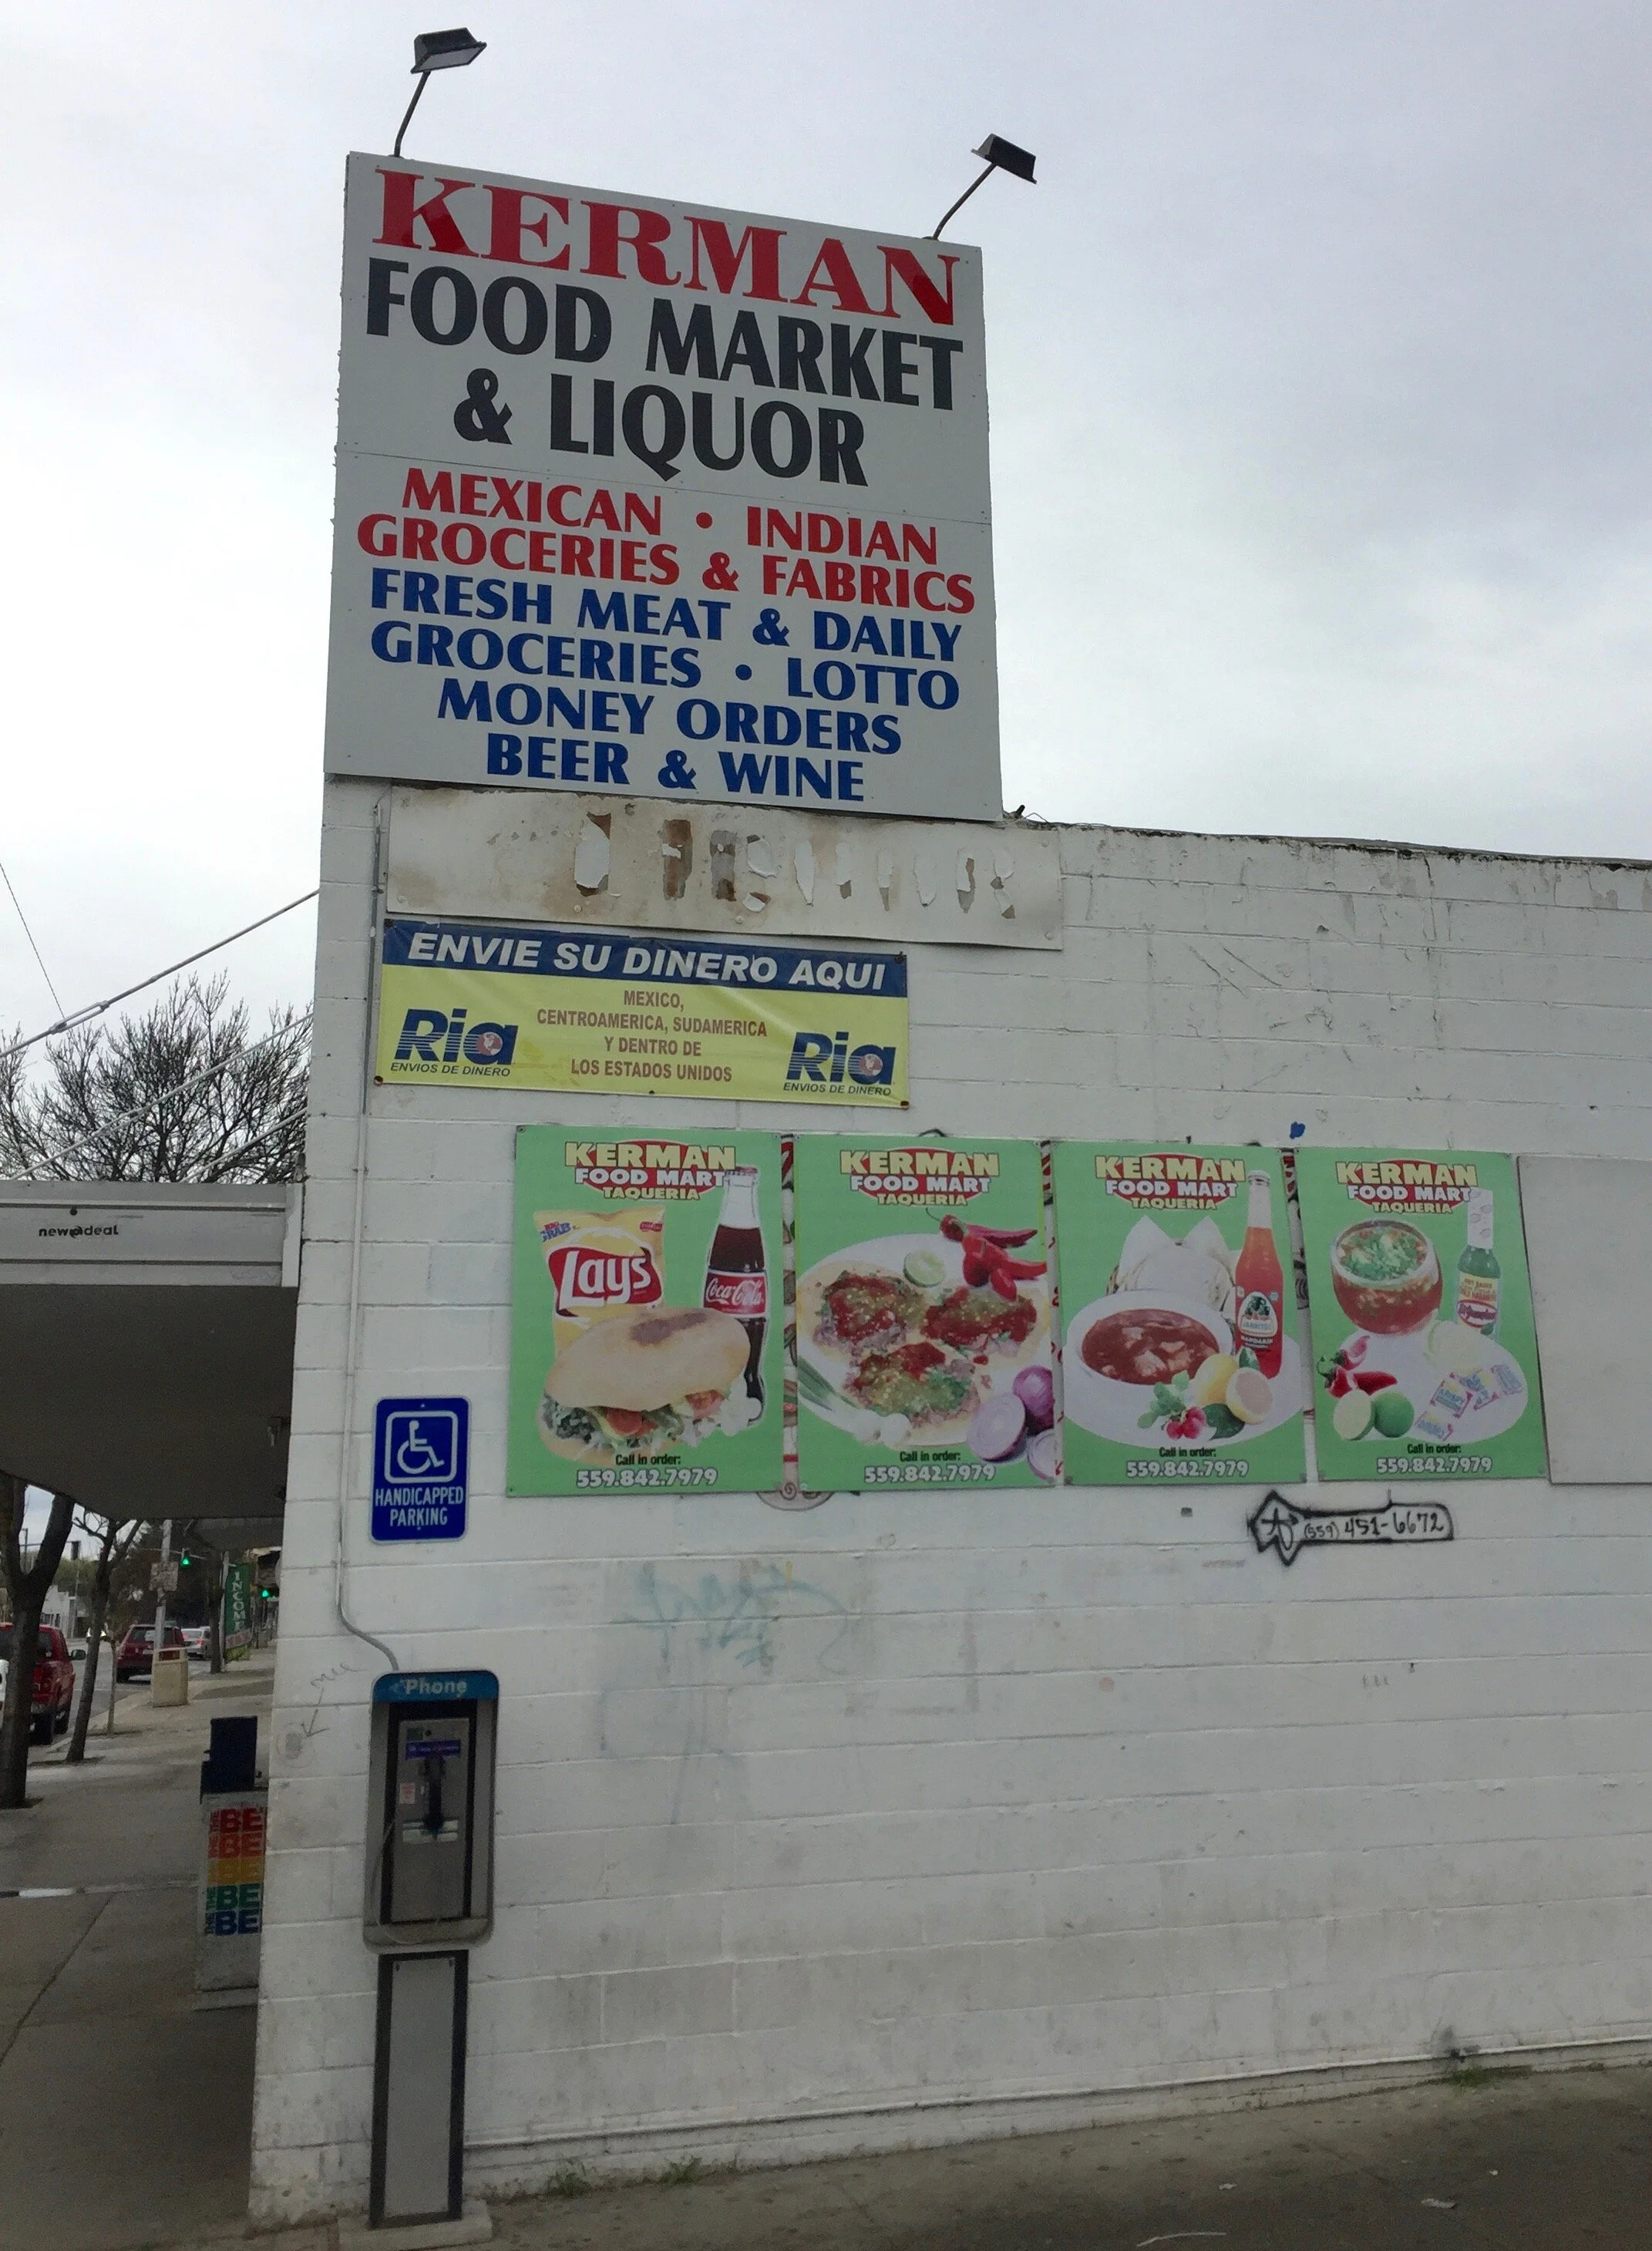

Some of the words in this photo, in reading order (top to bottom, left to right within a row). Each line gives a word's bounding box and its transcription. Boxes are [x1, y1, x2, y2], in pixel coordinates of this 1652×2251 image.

[372, 167, 961, 326] KERMAN
[367, 257, 611, 363] FOOD
[645, 298, 963, 410] MARKET
[454, 368, 513, 446] &
[550, 374, 868, 486] LIQUOR
[402, 468, 661, 536] MEXICAN
[747, 506, 937, 564] INDIAN
[358, 513, 679, 586] GROCERIES
[703, 552, 739, 591] &
[762, 556, 976, 614] FABRICS
[371, 567, 552, 624] FRESH
[578, 590, 732, 641] MEAT
[752, 608, 789, 646] &
[813, 611, 963, 662] DAILY
[371, 621, 701, 688] GROCERIES
[787, 658, 961, 711] LOTTO
[438, 678, 654, 735] MONEY
[677, 699, 901, 755] ORDERS
[487, 733, 629, 785] BEER
[658, 750, 697, 790] &
[718, 752, 865, 802] WINE
[408, 932, 542, 968] ENVIE
[553, 942, 612, 972] SU
[622, 947, 778, 984] DINERO
[788, 959, 886, 991] AQUI
[624, 990, 685, 1012] MEXICO,
[537, 1008, 668, 1035] CENTROAMERICA,
[673, 1016, 767, 1037] SUDAMERICA
[394, 1008, 518, 1065] Ria
[604, 1036, 614, 1051] Y
[619, 1037, 678, 1055] DENTRO
[683, 1041, 702, 1056] DE
[786, 1031, 897, 1085] Ria
[391, 1062, 438, 1073] ENVIOS
[442, 1065, 459, 1075] DE
[463, 1066, 510, 1077] DINERO
[571, 1058, 600, 1075] LOS
[604, 1061, 671, 1079] ESTADOS
[677, 1065, 732, 1082] UNIDOS
[783, 1082, 826, 1092] ENVIOS
[829, 1085, 844, 1094] DE
[848, 1085, 891, 1095] DINERO
[565, 1142, 736, 1169] KERMAN
[839, 1150, 999, 1176] KERMAN
[575, 1169, 648, 1185] FOOD
[656, 1169, 727, 1186] MART
[1095, 1156, 1246, 1182] KERMAN
[1336, 1162, 1477, 1186] KERMAN
[602, 1186, 700, 1200] TAQUERIA
[850, 1175, 919, 1191] FOOD
[927, 1176, 991, 1193] MART
[1105, 1180, 1171, 1195] FOOD
[1177, 1181, 1238, 1198] MART
[1347, 1185, 1408, 1200] FOOD
[1415, 1187, 1472, 1202] MART
[877, 1193, 967, 1206] TAQUERIA
[1131, 1197, 1216, 1210] TAQUERIA
[1372, 1201, 1453, 1213] TAQUERIA
[559, 1250, 651, 1309] Lay's
[900, 1451, 919, 1462] Call
[932, 1451, 961, 1462] order:
[1159, 1446, 1176, 1458] Call
[1189, 1446, 1216, 1459] order:
[1407, 1443, 1423, 1455] Call
[1435, 1443, 1462, 1455] order:
[615, 1454, 636, 1465] Call
[650, 1454, 681, 1465] order:
[1127, 1461, 1249, 1478] 559.842.7979
[1377, 1457, 1492, 1473] 559.842.7979
[575, 1468, 718, 1488] 559.842.7979
[864, 1465, 996, 1482] 559.842.7979
[375, 1486, 463, 1506] HANDICAPPED
[389, 1507, 448, 1527] PARKING
[406, 1677, 467, 1698] Phone
